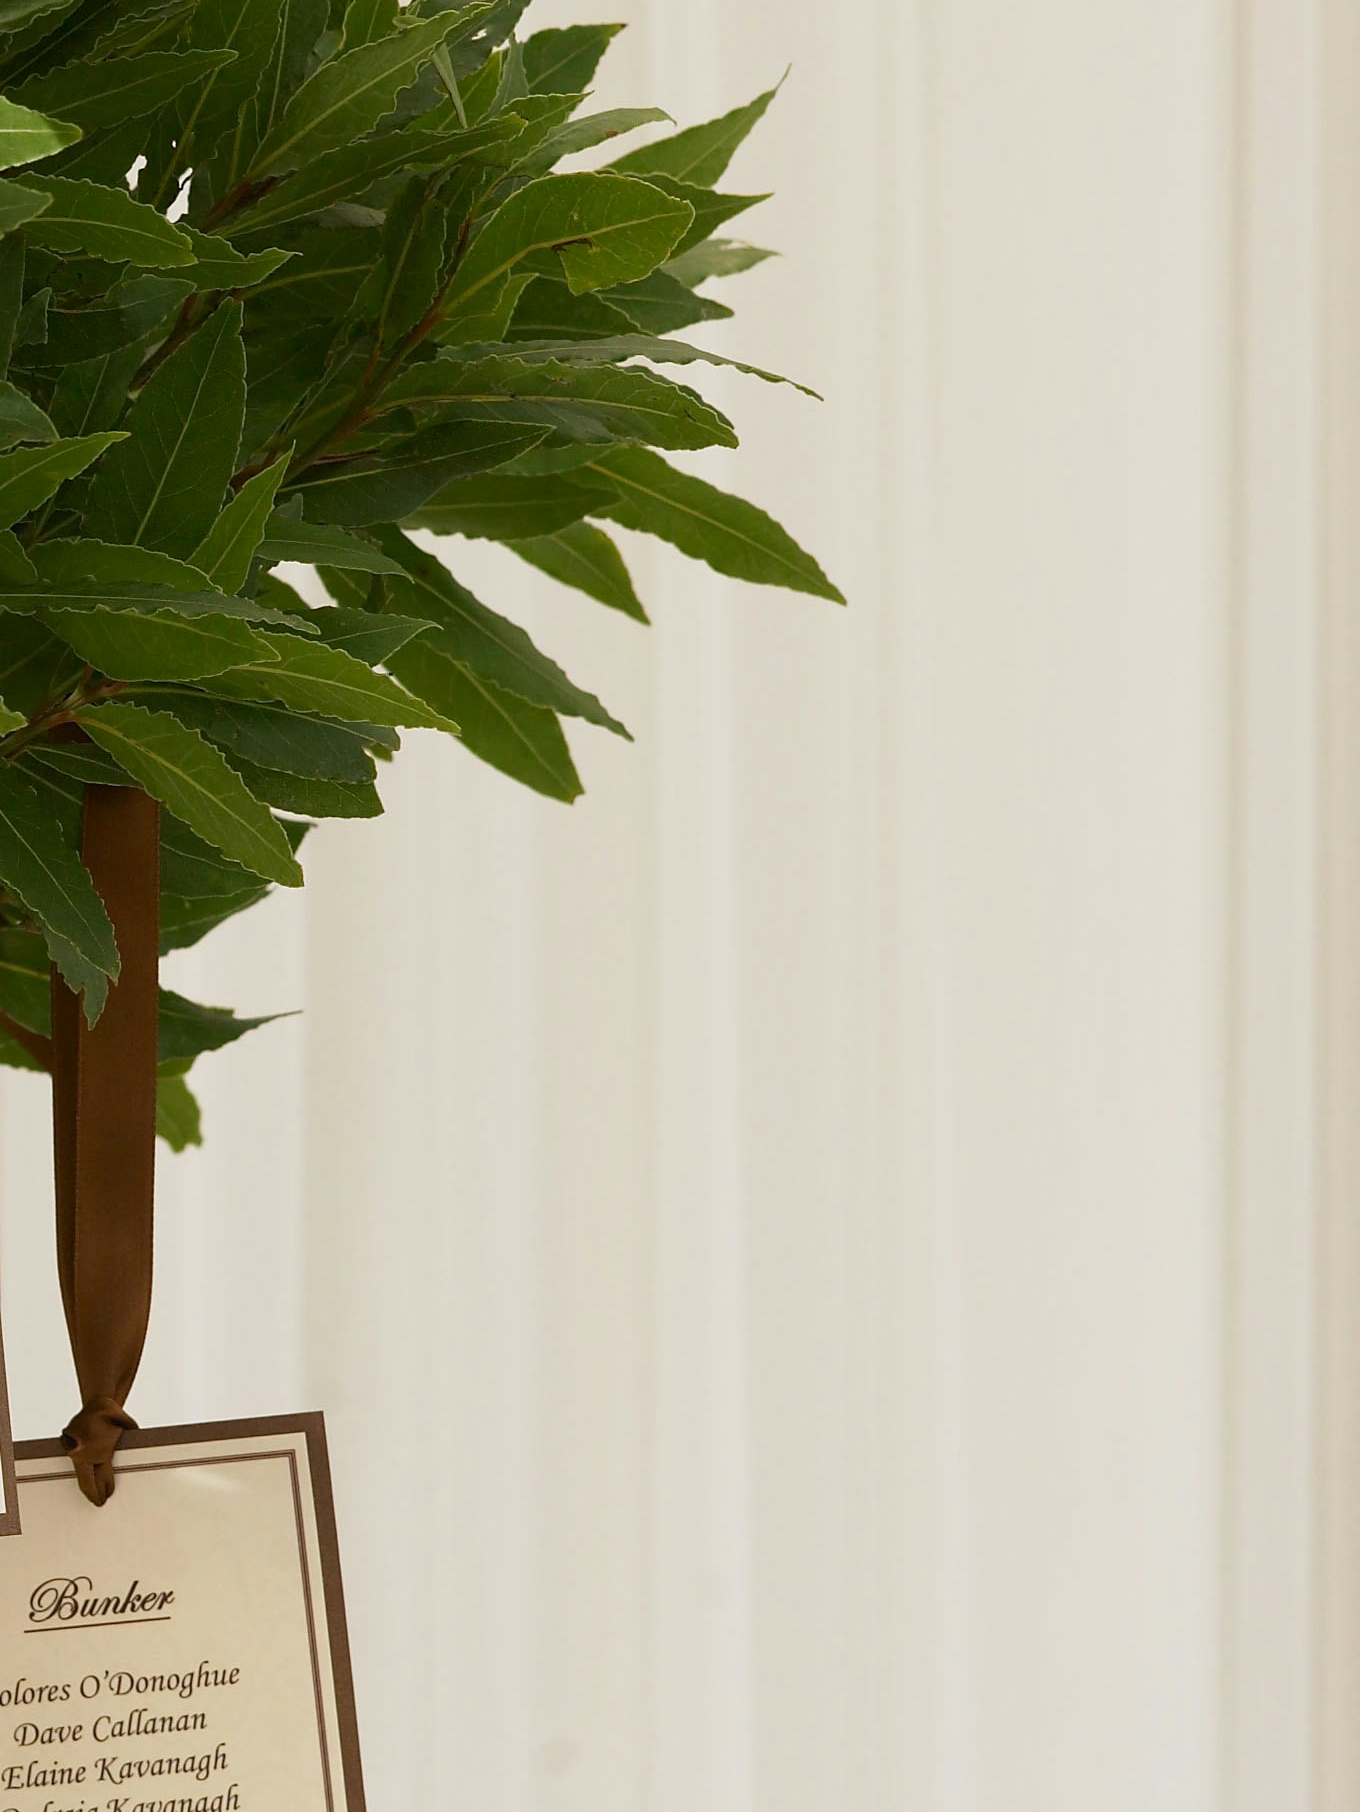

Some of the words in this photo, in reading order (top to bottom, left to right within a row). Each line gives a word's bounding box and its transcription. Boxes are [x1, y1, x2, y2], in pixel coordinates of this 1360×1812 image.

[28, 1575, 176, 1623] Bunker
[79, 1660, 240, 1699] O'Donoghue
[13, 1722, 84, 1747] Dave
[92, 1707, 207, 1743] Callanan
[1, 1760, 87, 1790] Elaine
[93, 1742, 228, 1786] Kavanagh
